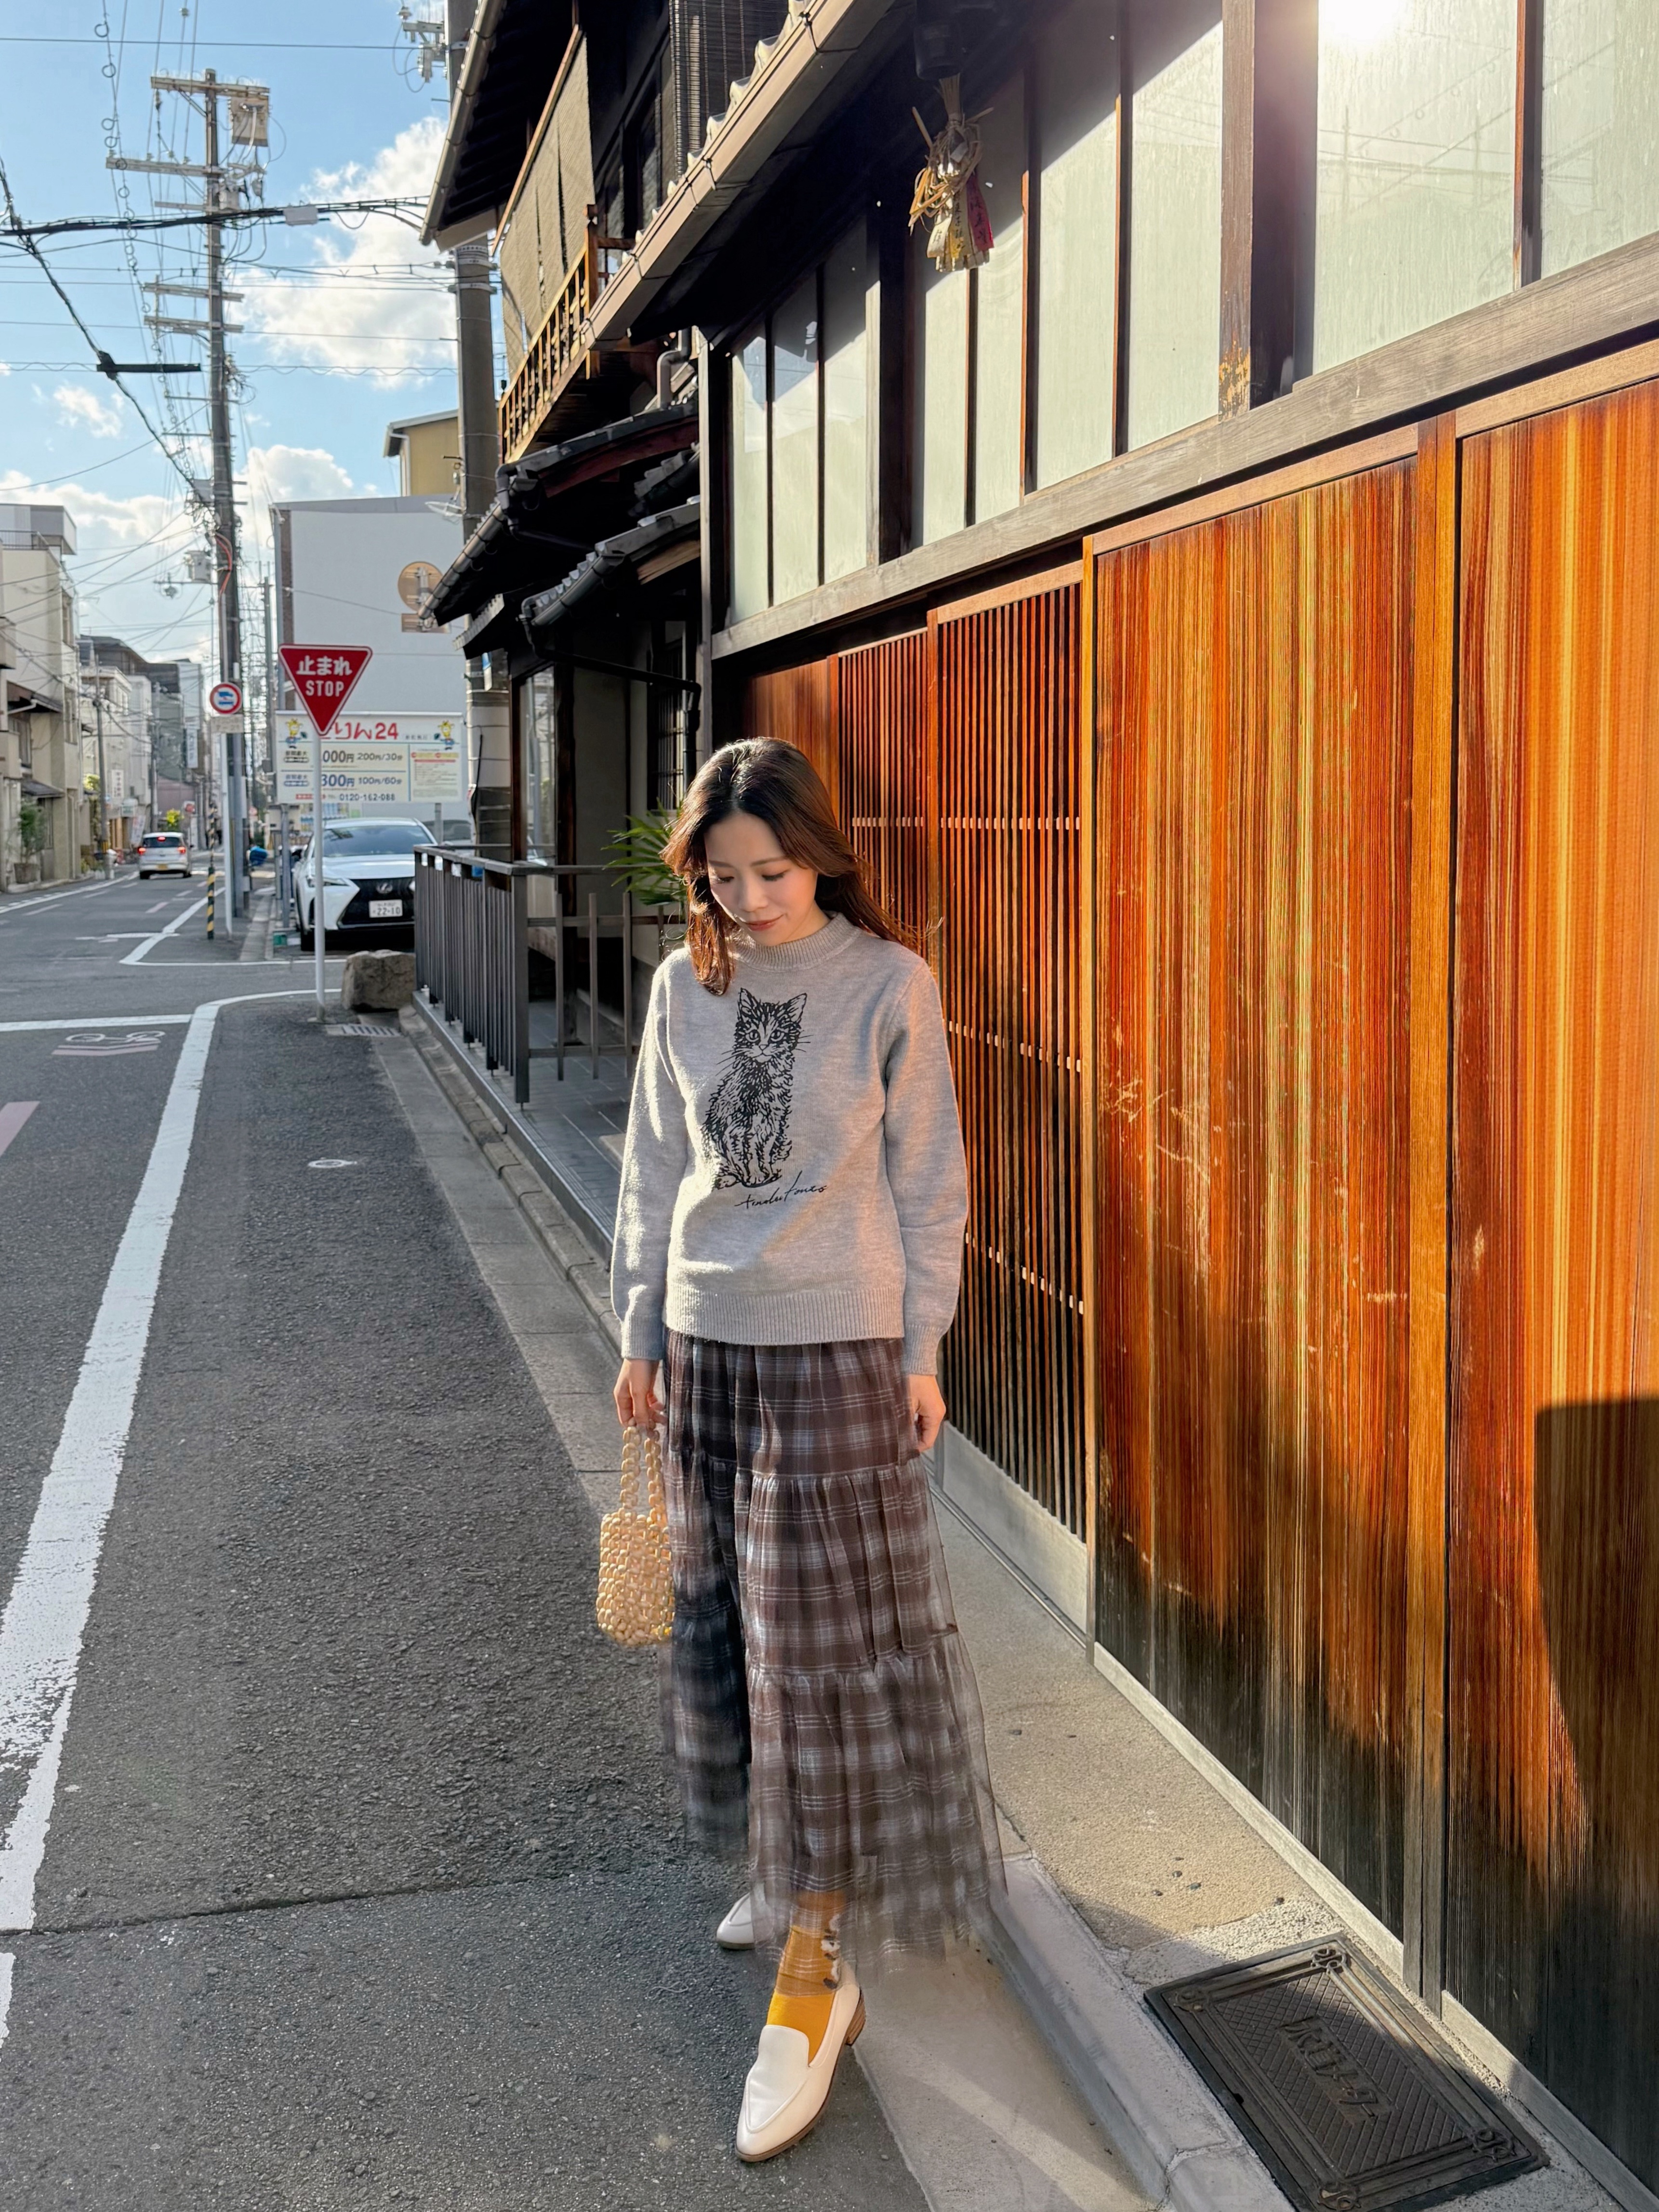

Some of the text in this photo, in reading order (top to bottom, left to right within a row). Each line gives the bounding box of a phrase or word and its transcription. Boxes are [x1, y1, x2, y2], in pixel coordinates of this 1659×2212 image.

[296, 655, 353, 676] 止まれ
[305, 680, 345, 697] STOP
[320, 722, 399, 740] りん24
[322, 750, 354, 763] 000円
